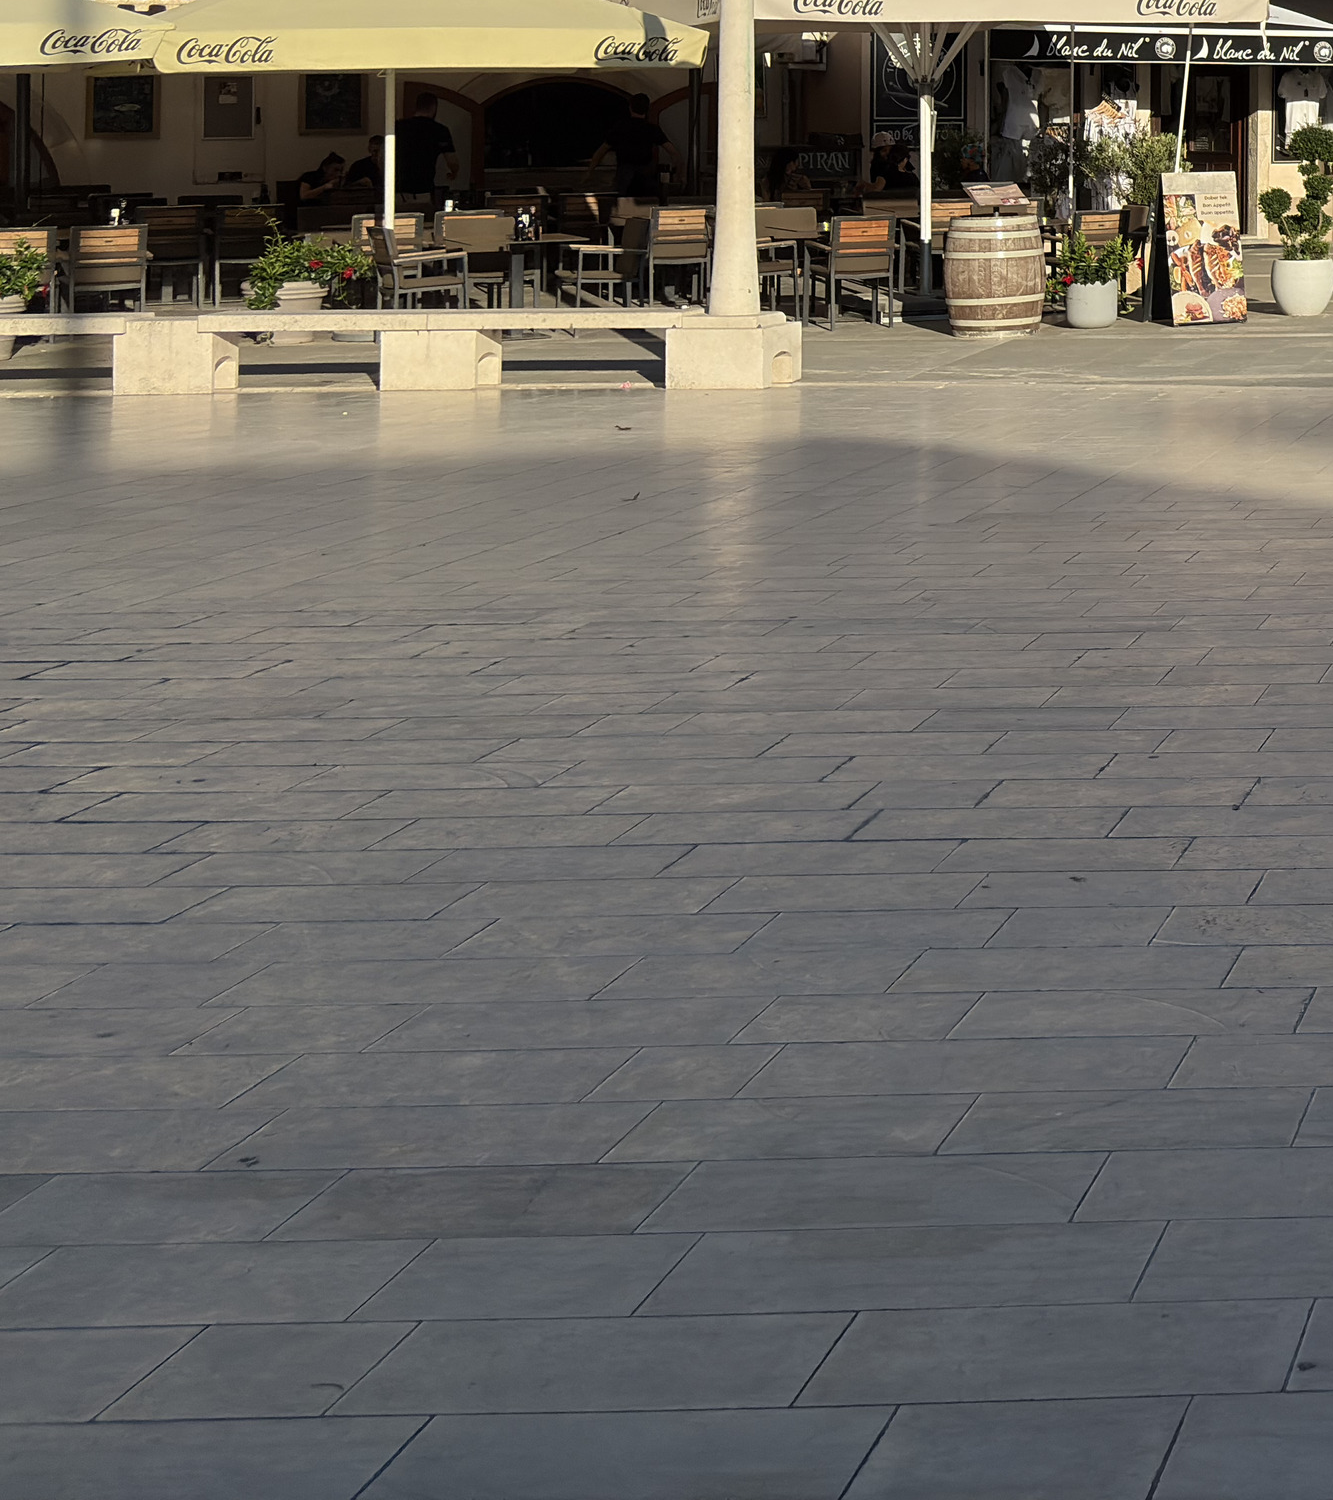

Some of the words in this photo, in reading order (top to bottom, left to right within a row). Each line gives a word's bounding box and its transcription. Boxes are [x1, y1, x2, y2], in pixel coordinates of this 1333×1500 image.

[1093, 38, 1113, 57] du
[1117, 37, 1144, 59] Nil
[1213, 38, 1253, 60] Blanc
[1279, 41, 1305, 62] Nil
